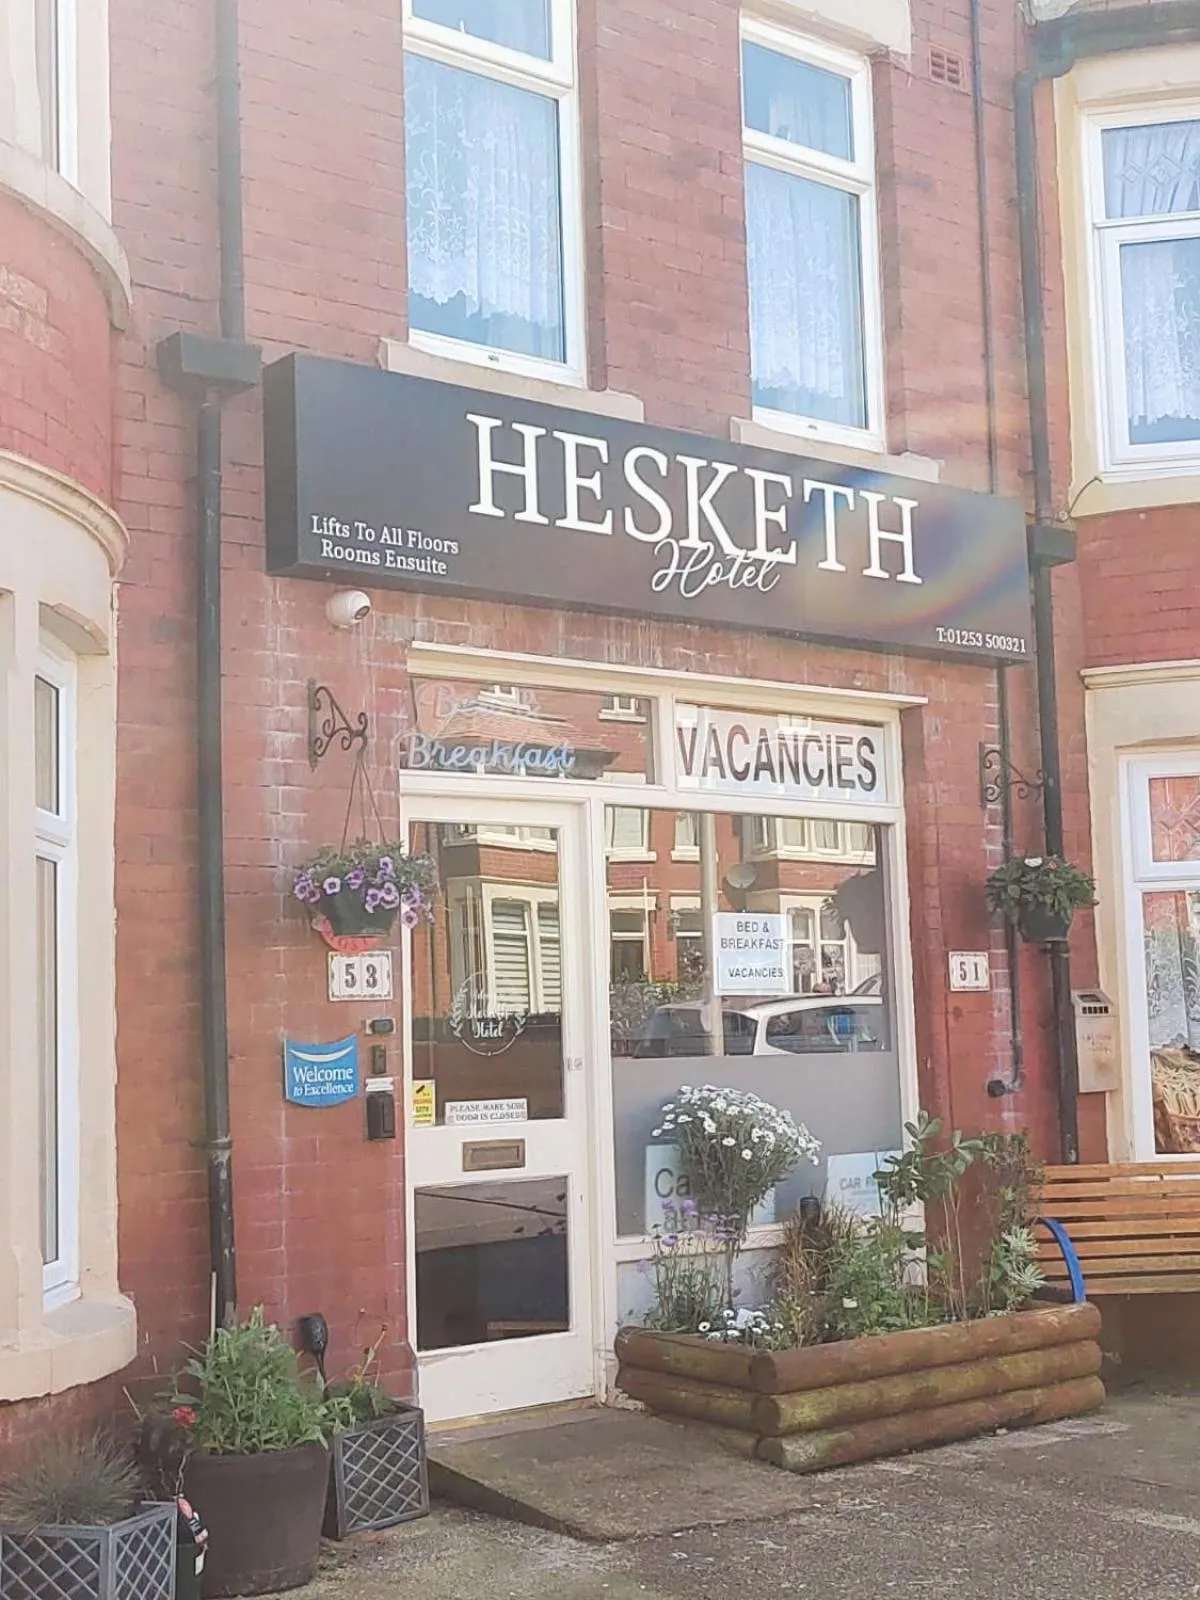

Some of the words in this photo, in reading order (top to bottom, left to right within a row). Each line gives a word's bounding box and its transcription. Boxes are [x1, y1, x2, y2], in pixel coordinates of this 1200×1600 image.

[466, 412, 923, 585] HESKETH
[311, 515, 350, 539] Lifts
[354, 521, 375, 542] To
[379, 526, 402, 546] All
[407, 530, 459, 555] Floors
[321, 538, 381, 566] Rooms
[385, 550, 447, 575] Ensuite
[651, 537, 781, 598] Hotel
[936, 627, 983, 647] T:01253
[985, 633, 1026, 653] 500321
[394, 731, 576, 769] Breakfast
[676, 722, 878, 793] VACANCIES
[736, 920, 759, 933] BED
[762, 921, 770, 933] &
[720, 937, 784, 950] BREAKFAST
[344, 962, 378, 989] 53
[728, 967, 785, 978] VACANCIES
[959, 961, 980, 982] 51
[293, 1065, 354, 1083] Welcome
[293, 1085, 304, 1097] to
[304, 1082, 354, 1097] Excellence
